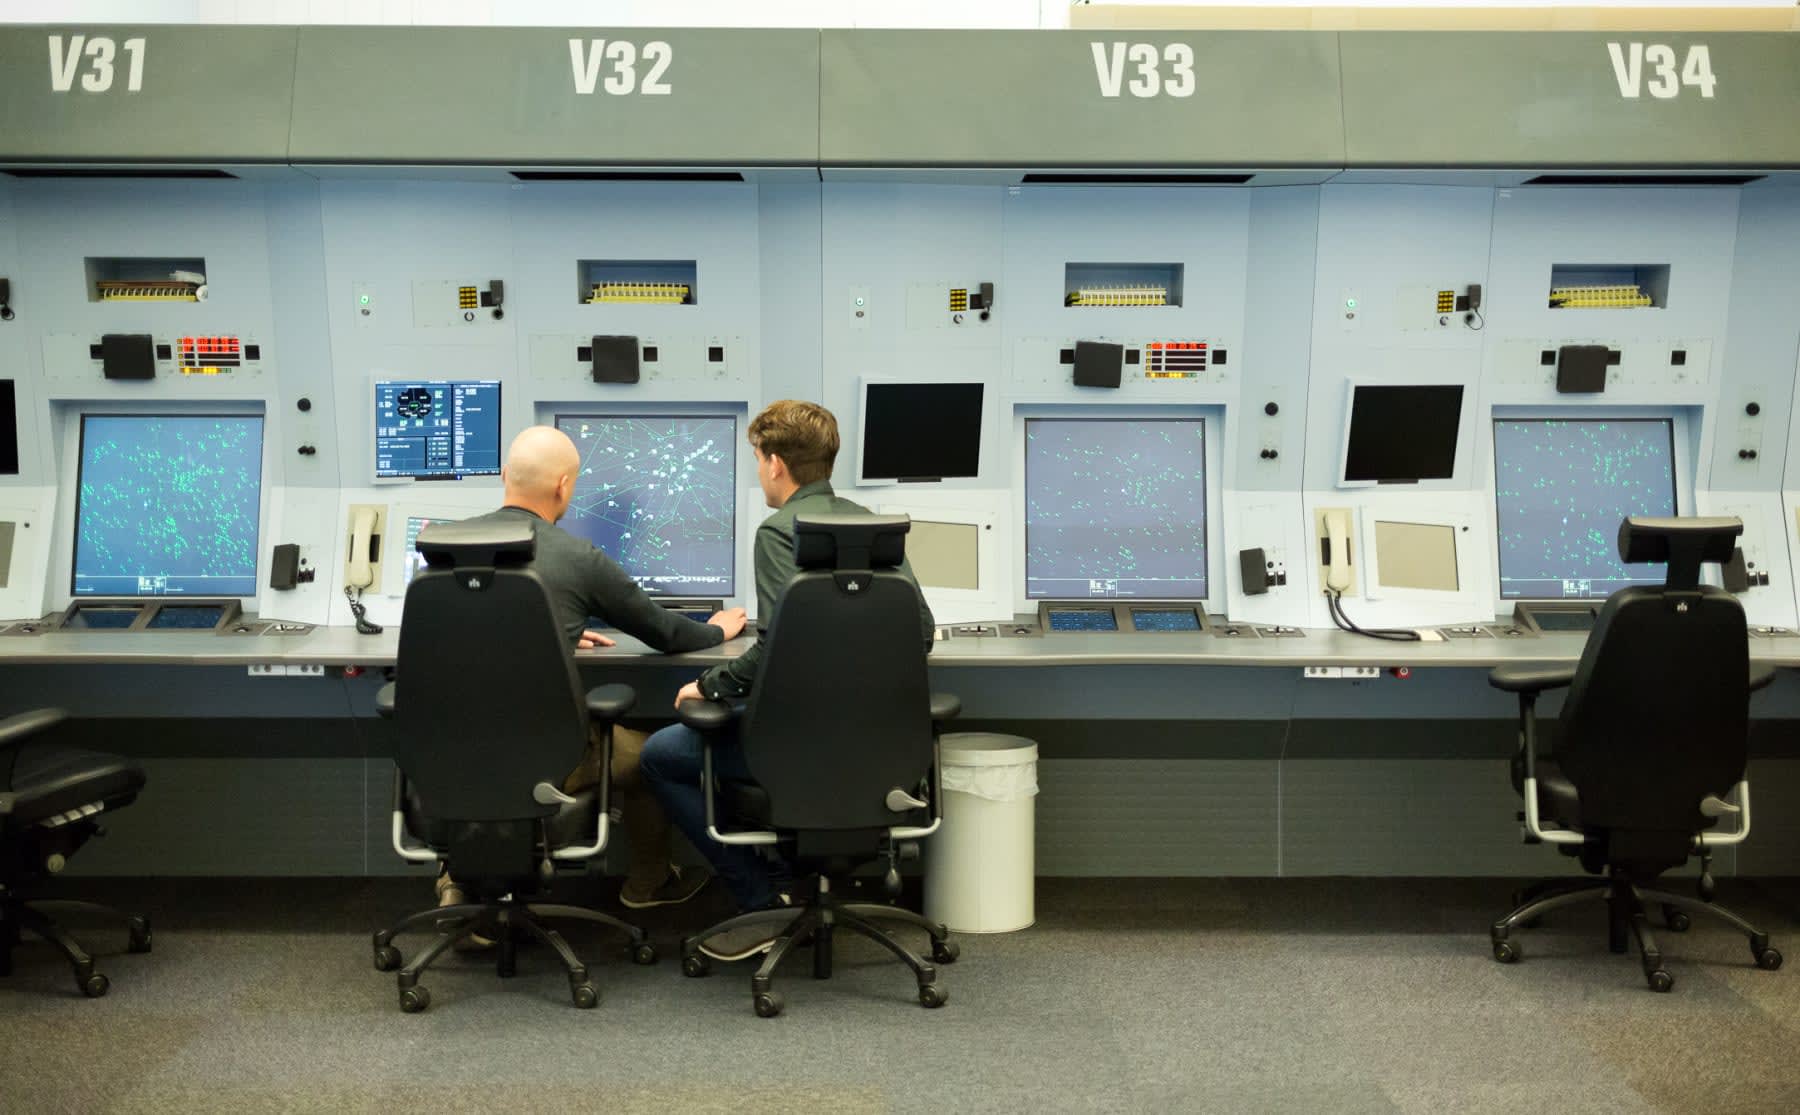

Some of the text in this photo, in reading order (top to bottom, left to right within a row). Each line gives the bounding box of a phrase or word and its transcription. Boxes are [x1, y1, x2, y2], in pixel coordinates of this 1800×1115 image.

[48, 35, 146, 93] V31
[568, 39, 673, 96] V32
[1091, 42, 1196, 98] V33
[1607, 43, 1717, 99] V34
